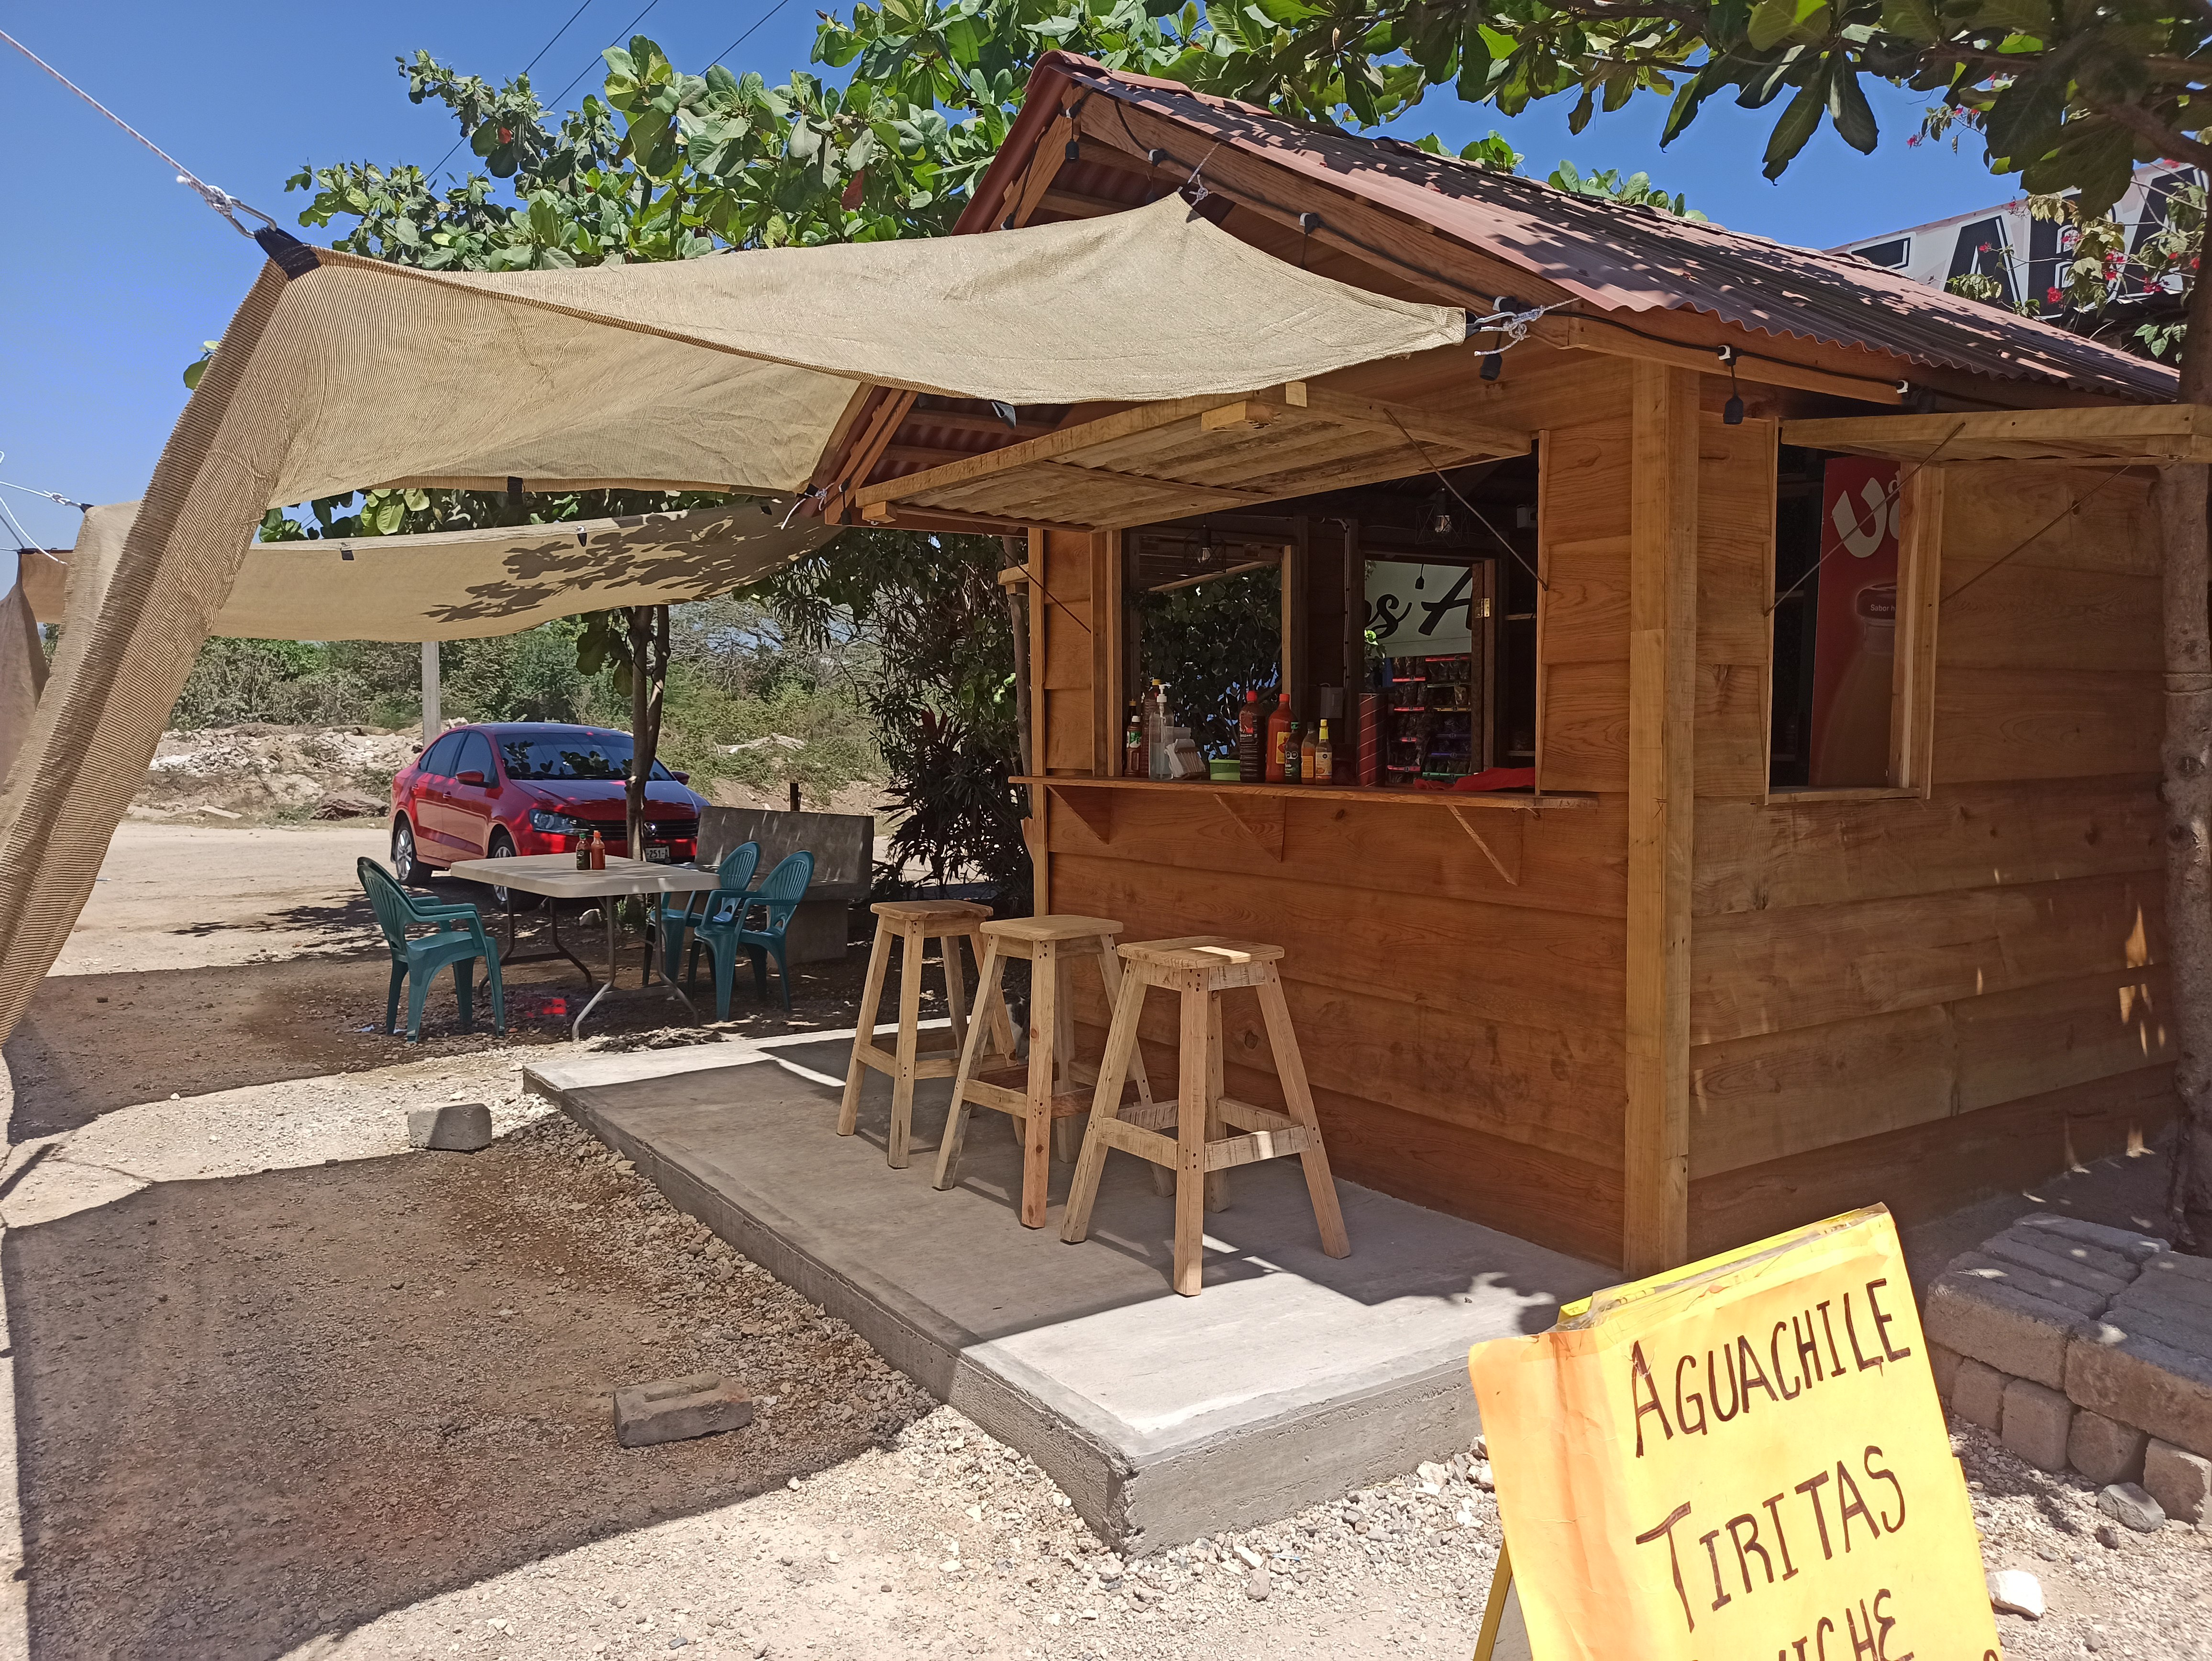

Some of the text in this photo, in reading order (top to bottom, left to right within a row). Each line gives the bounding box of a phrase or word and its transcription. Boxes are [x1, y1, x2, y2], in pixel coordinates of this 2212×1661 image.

[1871, 604, 1890, 612] Sabor
[1632, 1277, 1911, 1458] AGUACHILE
[1635, 1445, 1906, 1633] TIRITAS
